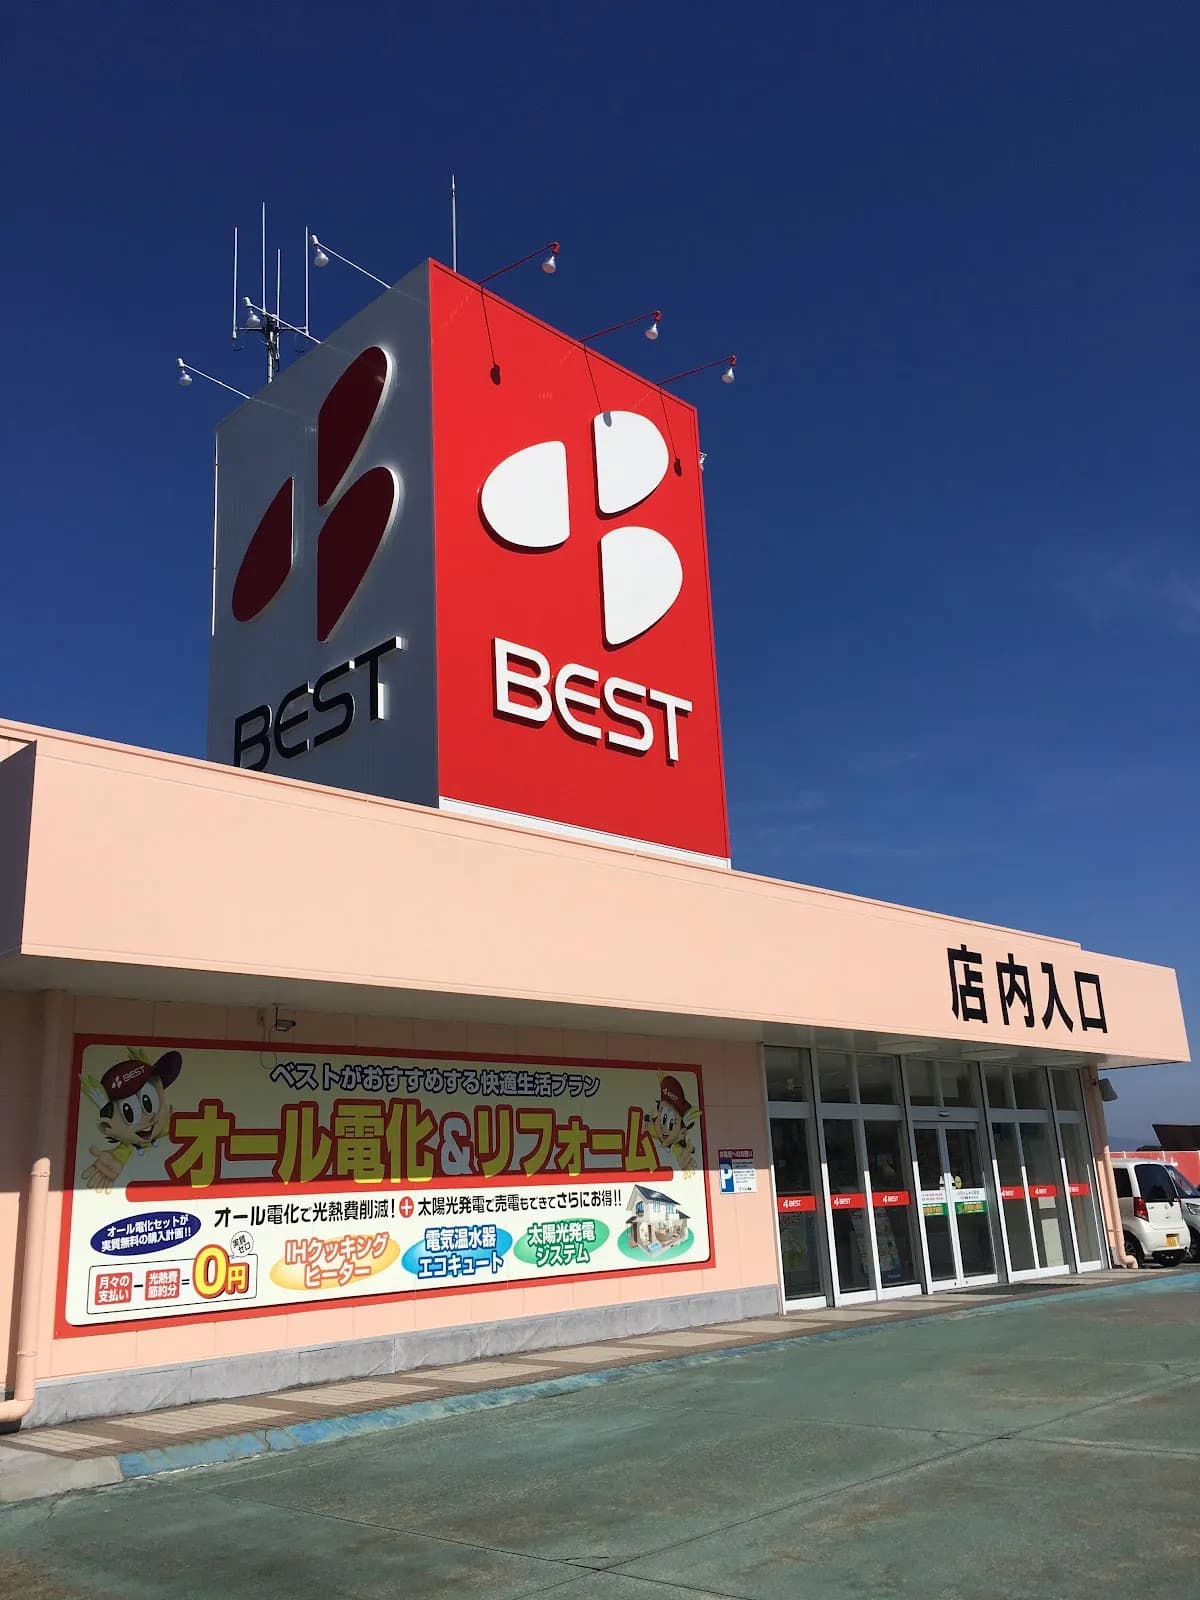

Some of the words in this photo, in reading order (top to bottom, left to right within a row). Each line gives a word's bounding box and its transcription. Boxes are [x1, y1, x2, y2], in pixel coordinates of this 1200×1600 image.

[234, 636, 404, 771] BEST
[493, 637, 693, 766] BEST
[947, 944, 1108, 1033] 店内入口
[122, 1065, 145, 1082] BEST
[270, 1061, 600, 1097] ベストがおすすめする快適生活プラン
[720, 1163, 733, 1190] P
[107, 1214, 189, 1238] オール電化セットが
[425, 1224, 497, 1251] 電気温水器
[527, 1220, 596, 1246] 太陽光発電
[285, 1232, 389, 1264] IHクッキング
[536, 1243, 590, 1268] システム
[148, 1271, 178, 1285] 光熱費
[305, 1261, 371, 1289] ヒーター
[418, 1252, 504, 1279] エコキュート
[99, 1288, 129, 1303] 支払い
[100, 1275, 129, 1289] 月々の
[148, 1285, 178, 1298] 節約分
